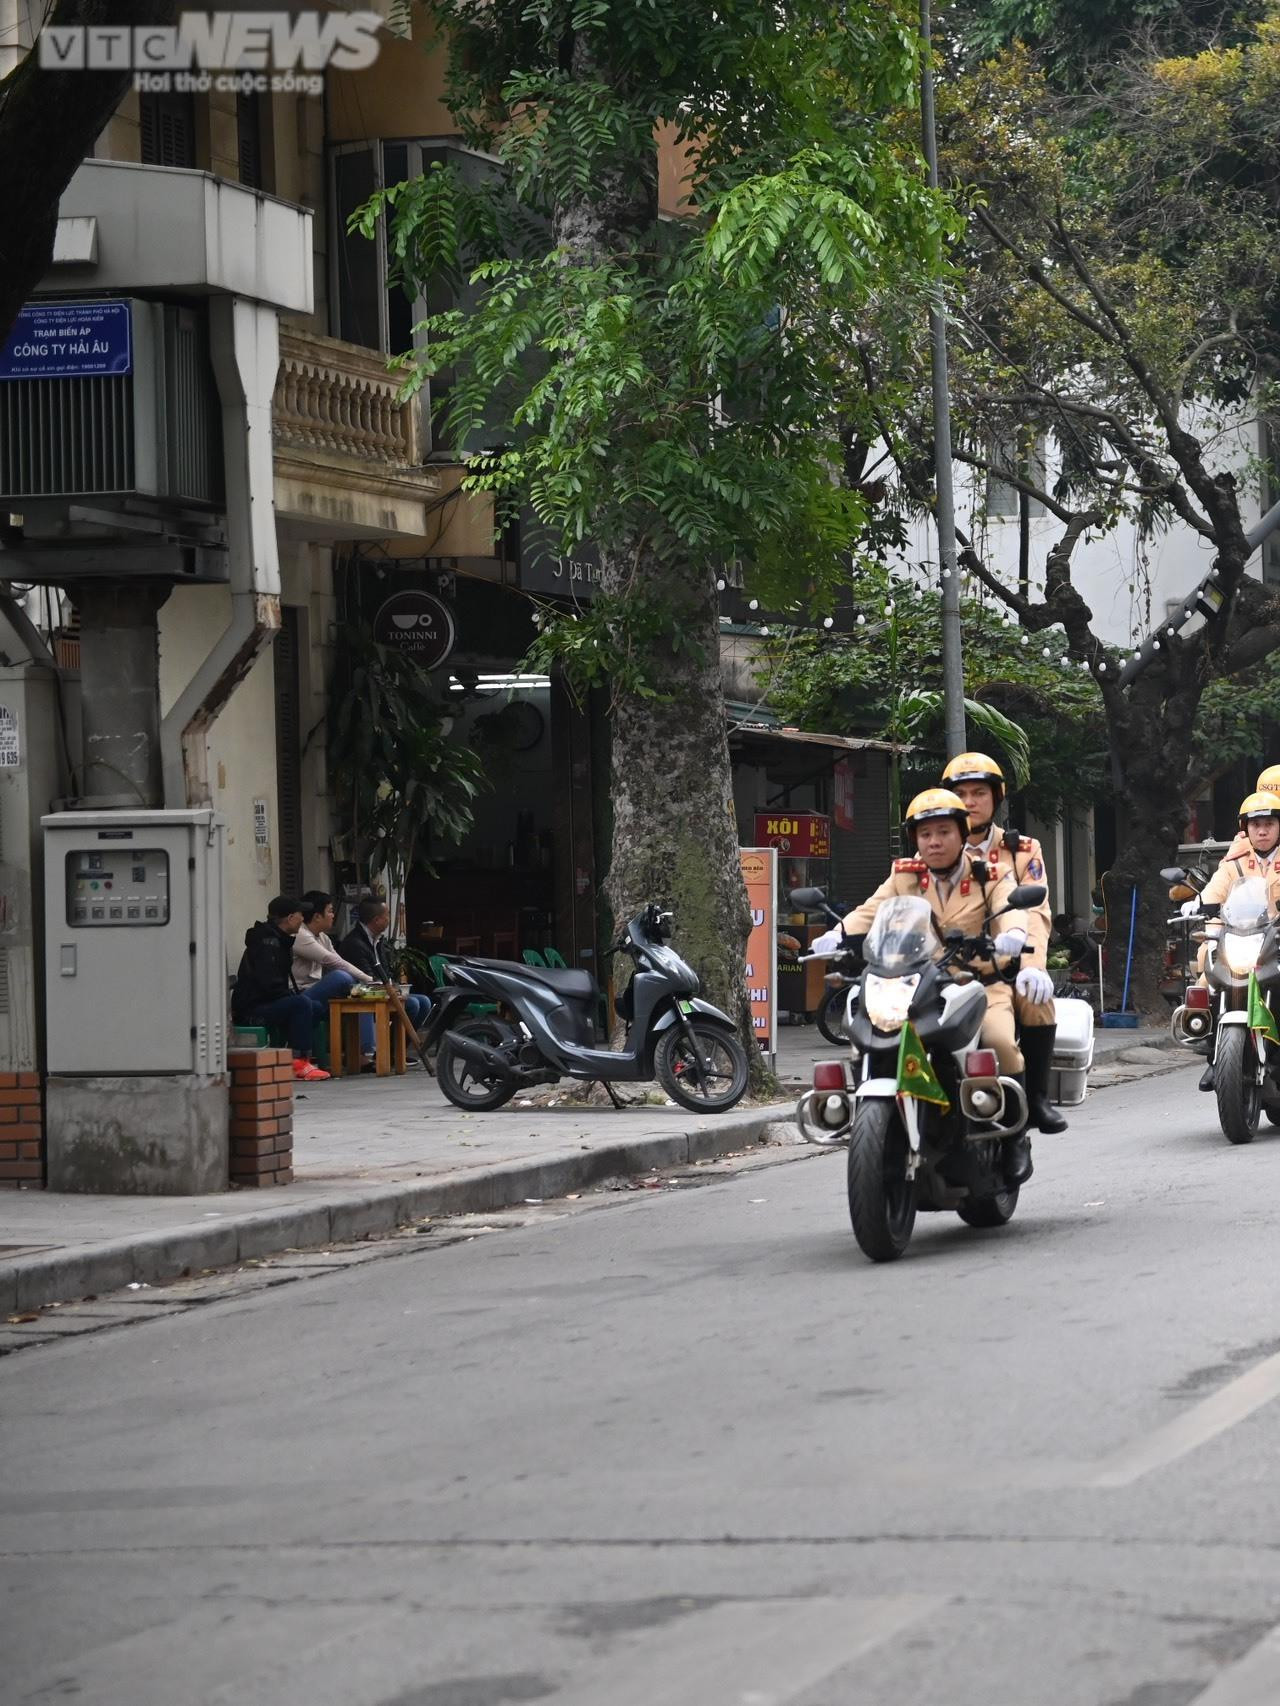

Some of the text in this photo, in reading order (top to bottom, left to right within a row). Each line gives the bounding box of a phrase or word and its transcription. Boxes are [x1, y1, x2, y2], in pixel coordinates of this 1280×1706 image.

[33, 325, 91, 340] TRẠM BIẾN ÁP
[13, 339, 109, 357] CÔNG TY HẢI ÂU
[388, 631, 437, 641] TONINNI
[767, 817, 799, 835] XÔI
[750, 909, 764, 926] U
[777, 963, 803, 972] ARIAN
[752, 1016, 765, 1028] HI
